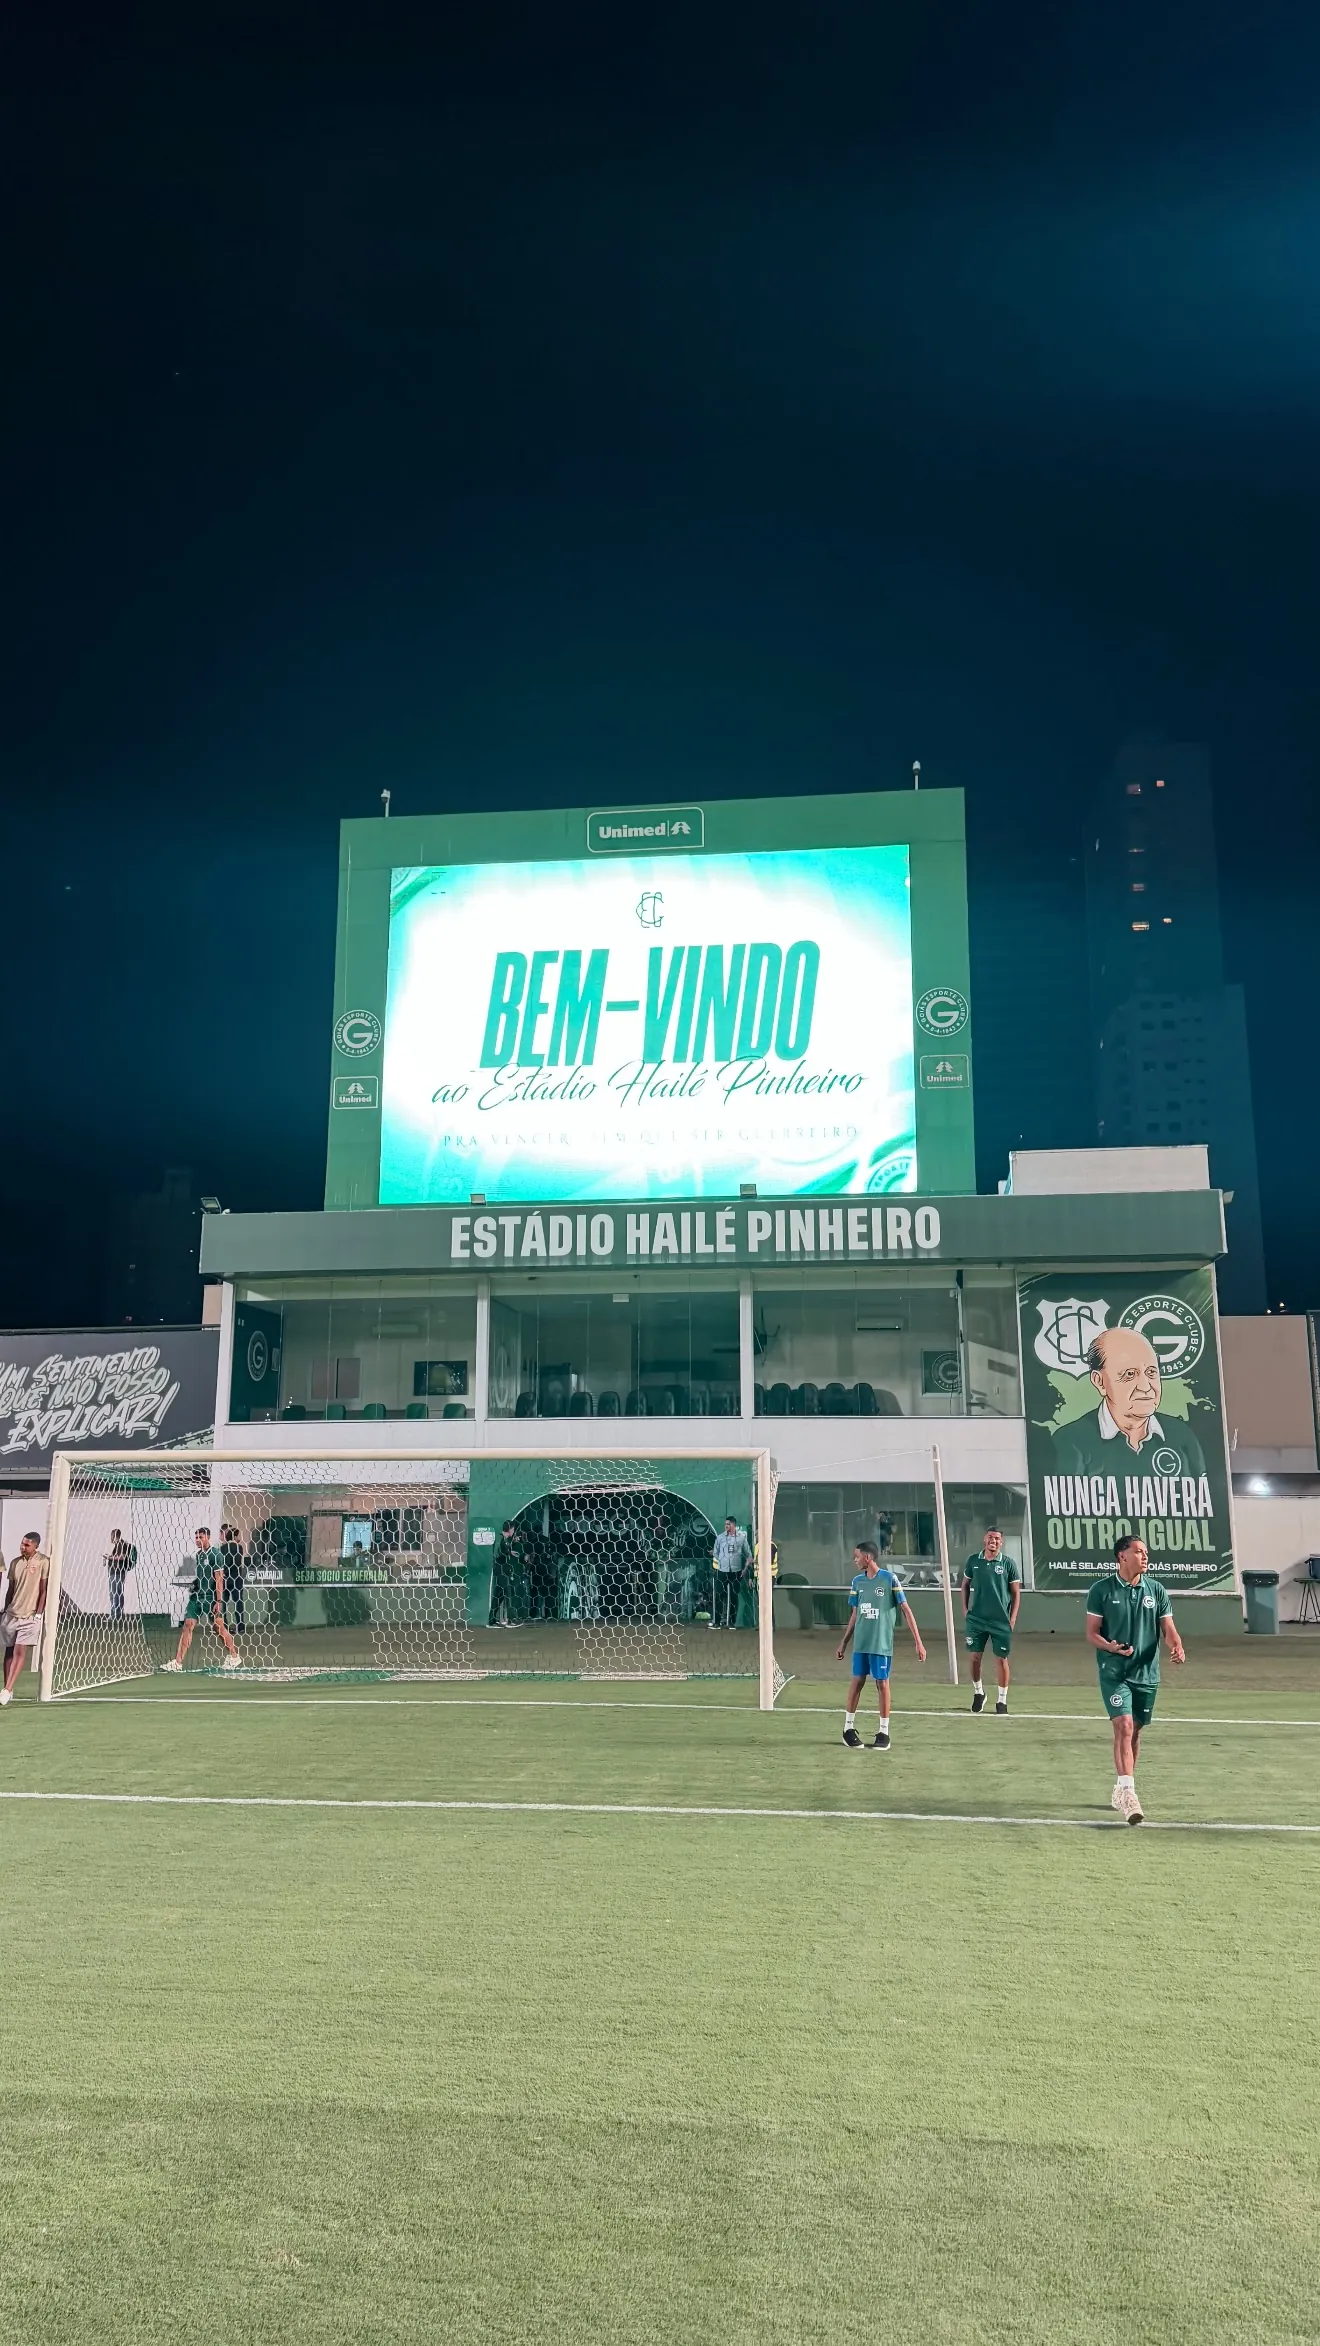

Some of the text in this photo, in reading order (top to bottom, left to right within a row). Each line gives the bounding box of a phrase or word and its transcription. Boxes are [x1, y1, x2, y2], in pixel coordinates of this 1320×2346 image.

[598, 822, 666, 839] Unimed
[343, 1012, 373, 1023] ESPORTE
[479, 940, 821, 1069] BEM-VINDO
[925, 990, 957, 1001] ESPORTE
[956, 999, 966, 1021] CLUBE
[925, 996, 960, 1028] G
[342, 1018, 374, 1049] G
[431, 1055, 869, 1111] ao Estádio Hailé Pinheiro
[926, 1074, 963, 1083] Unimed
[338, 1095, 372, 1104] Unimed
[444, 1135, 478, 1148] PRA
[450, 1205, 941, 1258] ESTÁDIO HAILÉ PINHEIRO
[1131, 1300, 1199, 1353] ESPORTE CLUBE
[32, 1346, 161, 1388] SENTIMENTO
[0, 1385, 49, 1418] QUE
[97, 1367, 171, 1405] POSSO
[0, 1381, 181, 1455] EXPLICAR!
[1043, 1472, 1214, 1517] NUNCA HAVERÁ
[1138, 1518, 1216, 1552] IGUAL
[342, 1569, 389, 1582] ESMERALDA
[1048, 1560, 1078, 1570] HAILÉ
[1147, 1561, 1171, 1571] OIÁS
[1171, 1563, 1218, 1572] PINHEIRO
